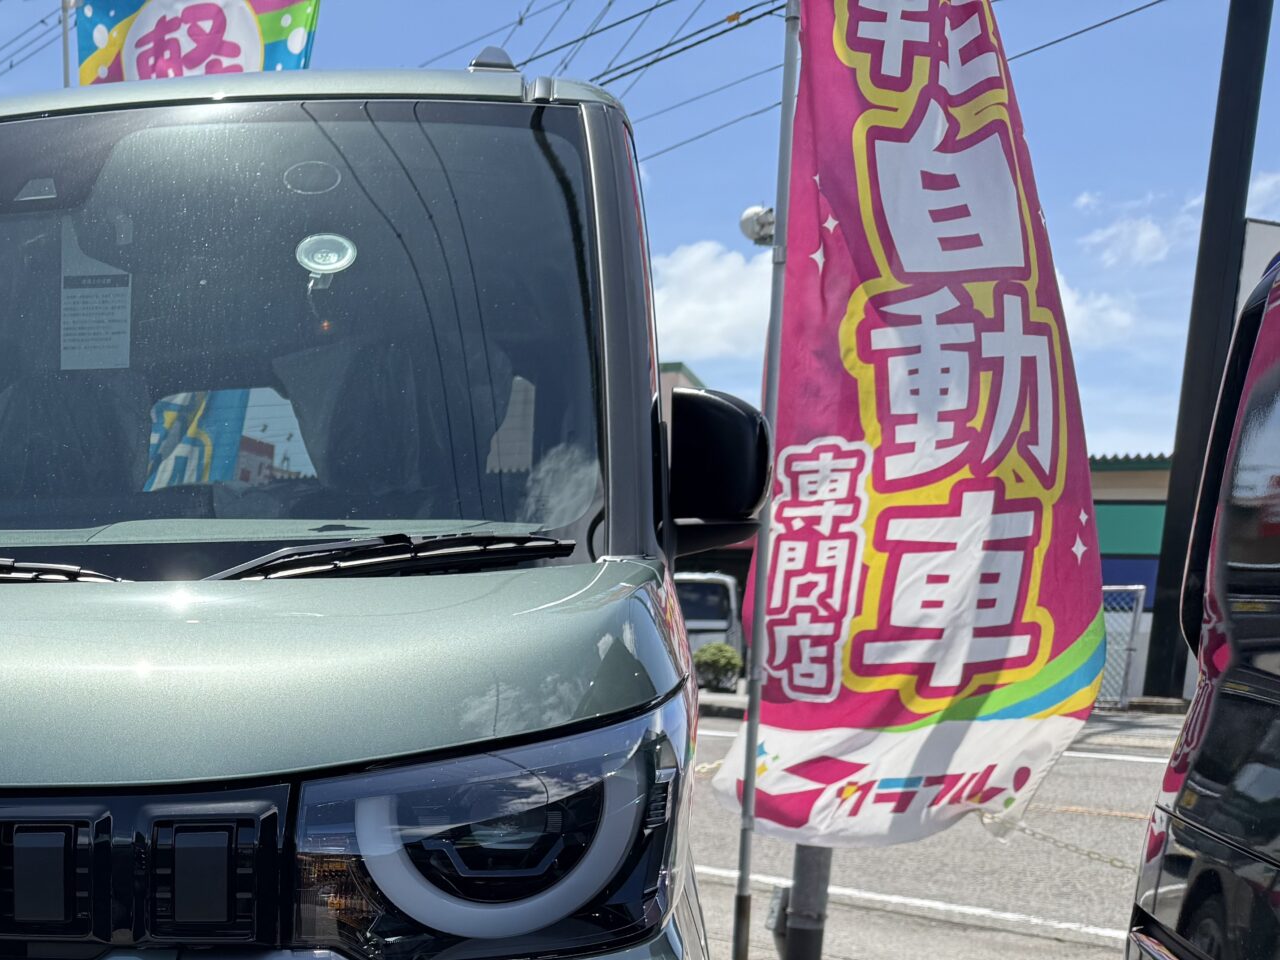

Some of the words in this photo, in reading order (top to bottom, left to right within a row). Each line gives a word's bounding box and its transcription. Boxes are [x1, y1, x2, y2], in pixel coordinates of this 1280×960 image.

[770, 452, 858, 689] 専門店
[836, 763, 1031, 817] カラフル!
